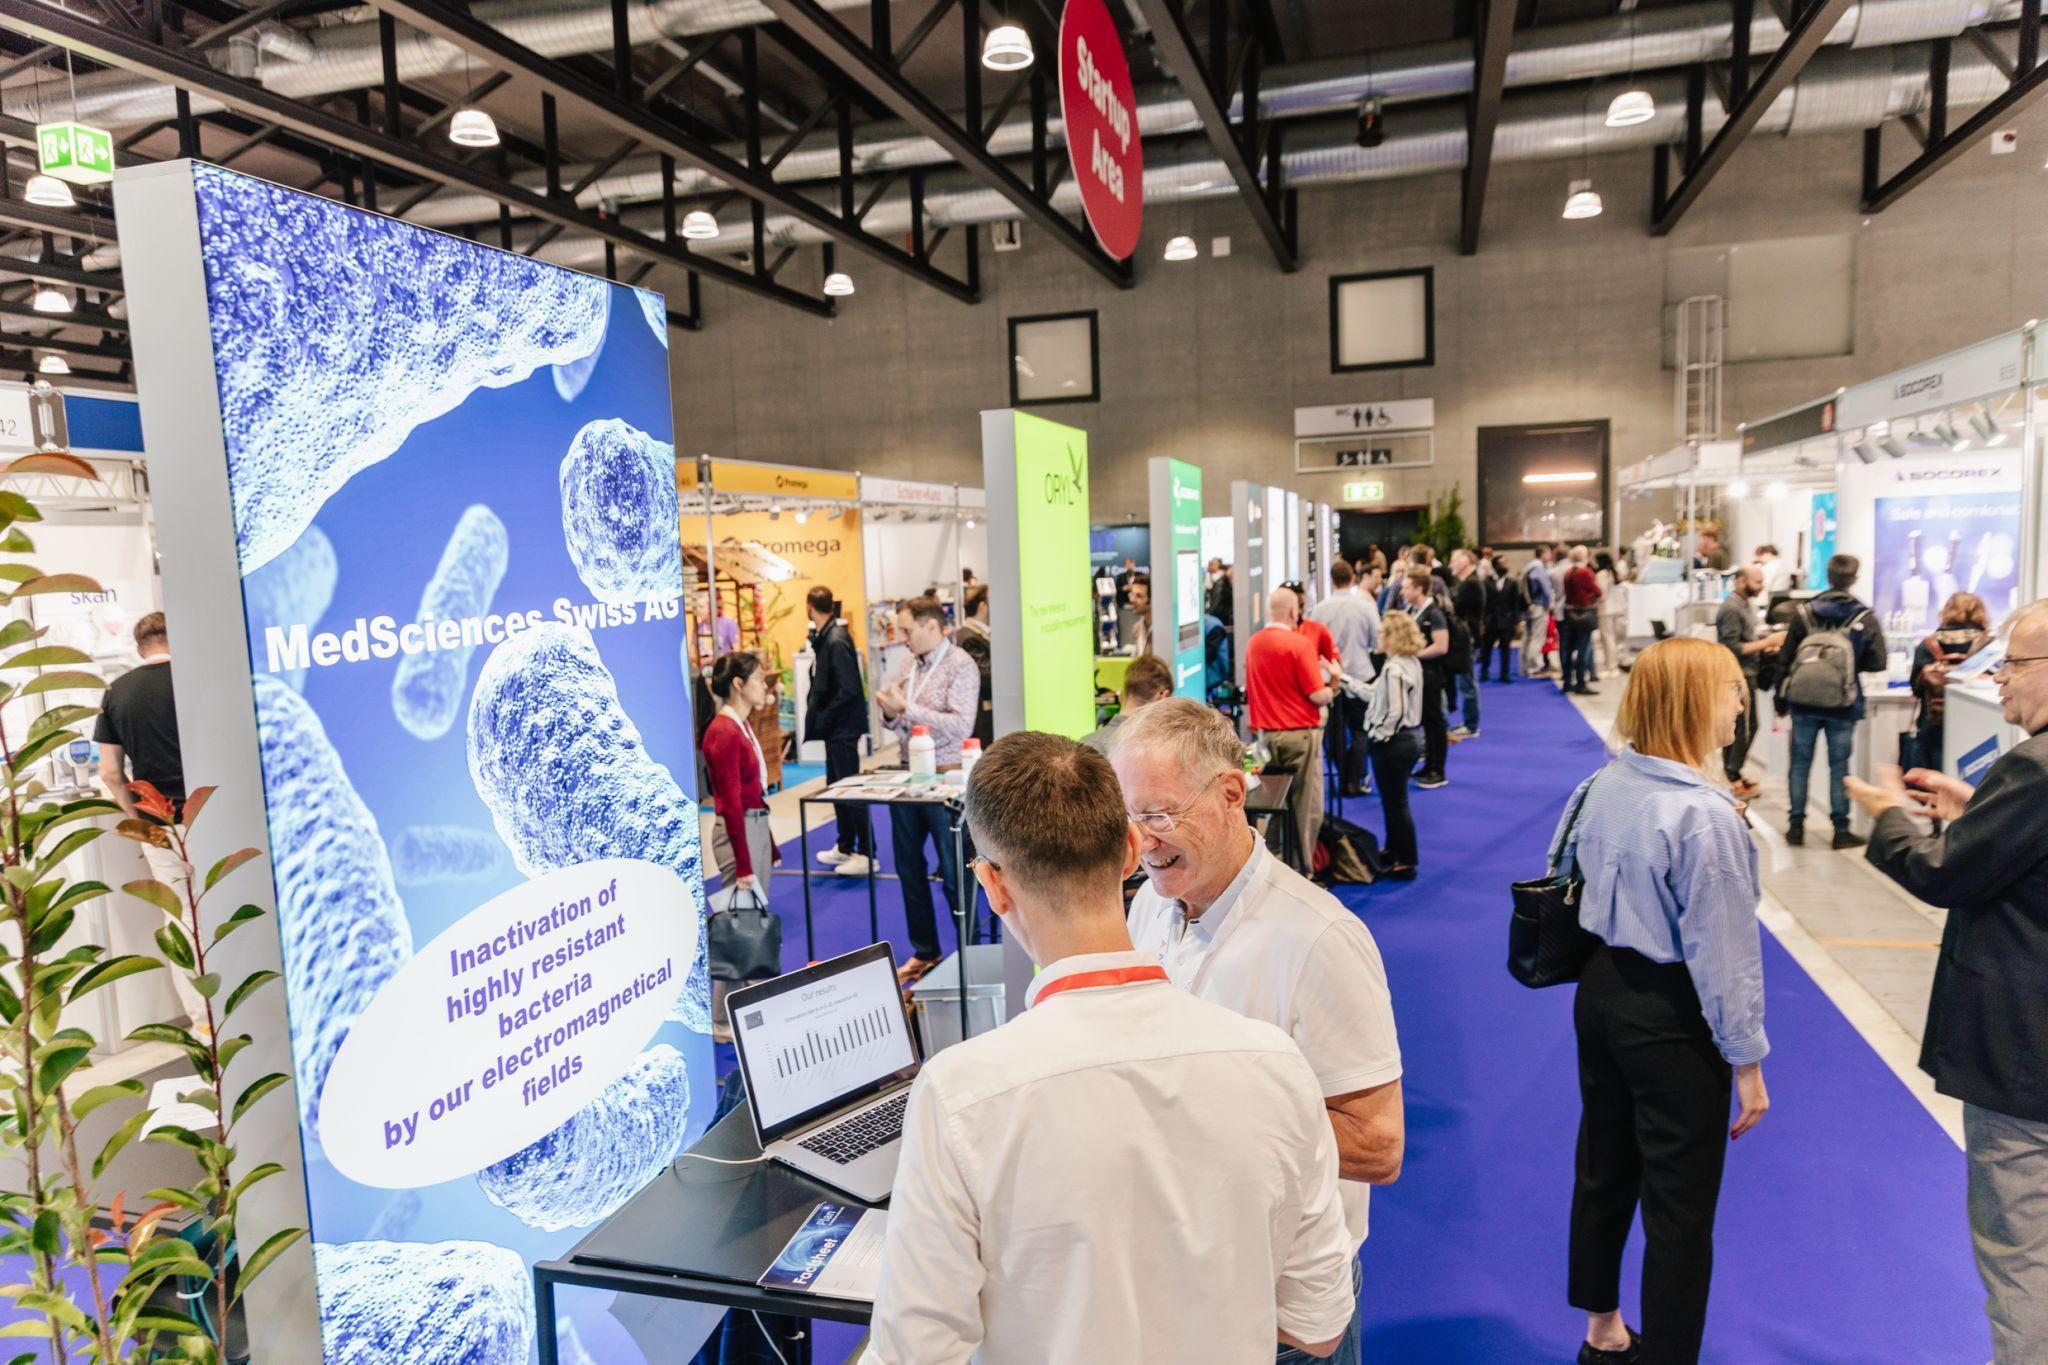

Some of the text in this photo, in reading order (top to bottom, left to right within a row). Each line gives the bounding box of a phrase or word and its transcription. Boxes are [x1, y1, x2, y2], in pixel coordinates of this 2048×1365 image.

[1077, 35, 1131, 155] Startup
[1092, 128, 1125, 204] Area
[784, 478, 809, 489] Promega
[1045, 473, 1075, 505] ORYL
[1910, 467, 2002, 480] SOCOREX
[265, 594, 680, 673] MedSciences Swiss AG
[450, 878, 617, 977] Inactivation of
[446, 914, 626, 1023] highly resistant
[498, 970, 592, 1038] bacteria
[815, 984, 837, 997] results
[384, 958, 672, 1149] by our electromagnetical
[522, 1054, 583, 1107] fields
